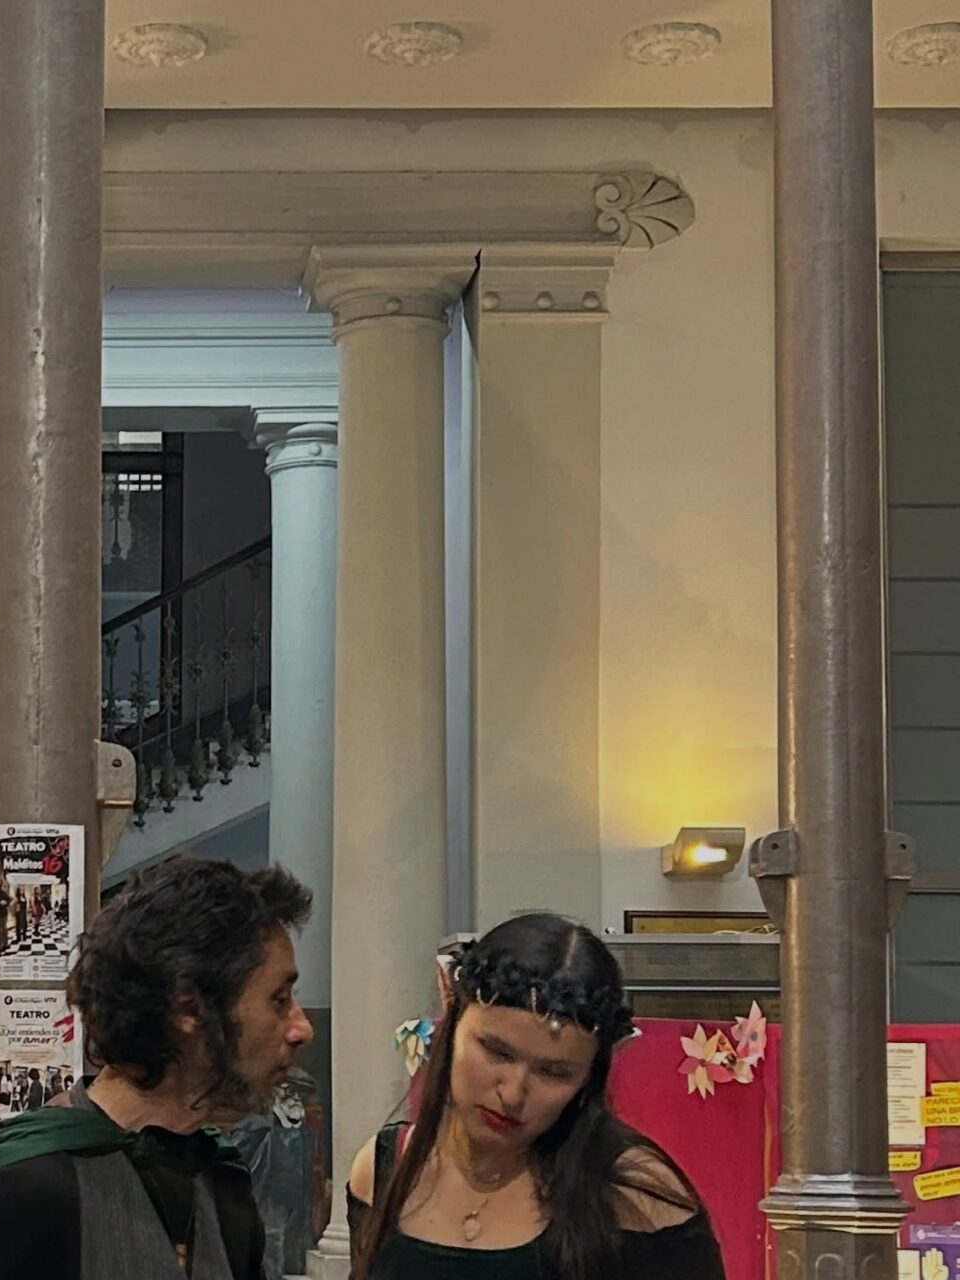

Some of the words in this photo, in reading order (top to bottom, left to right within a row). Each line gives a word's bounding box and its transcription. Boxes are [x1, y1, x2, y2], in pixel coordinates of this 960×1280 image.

[0, 841, 46, 852] TEATRO
[3, 858, 43, 870] Malditos
[10, 1010, 50, 1019] TEATRO
